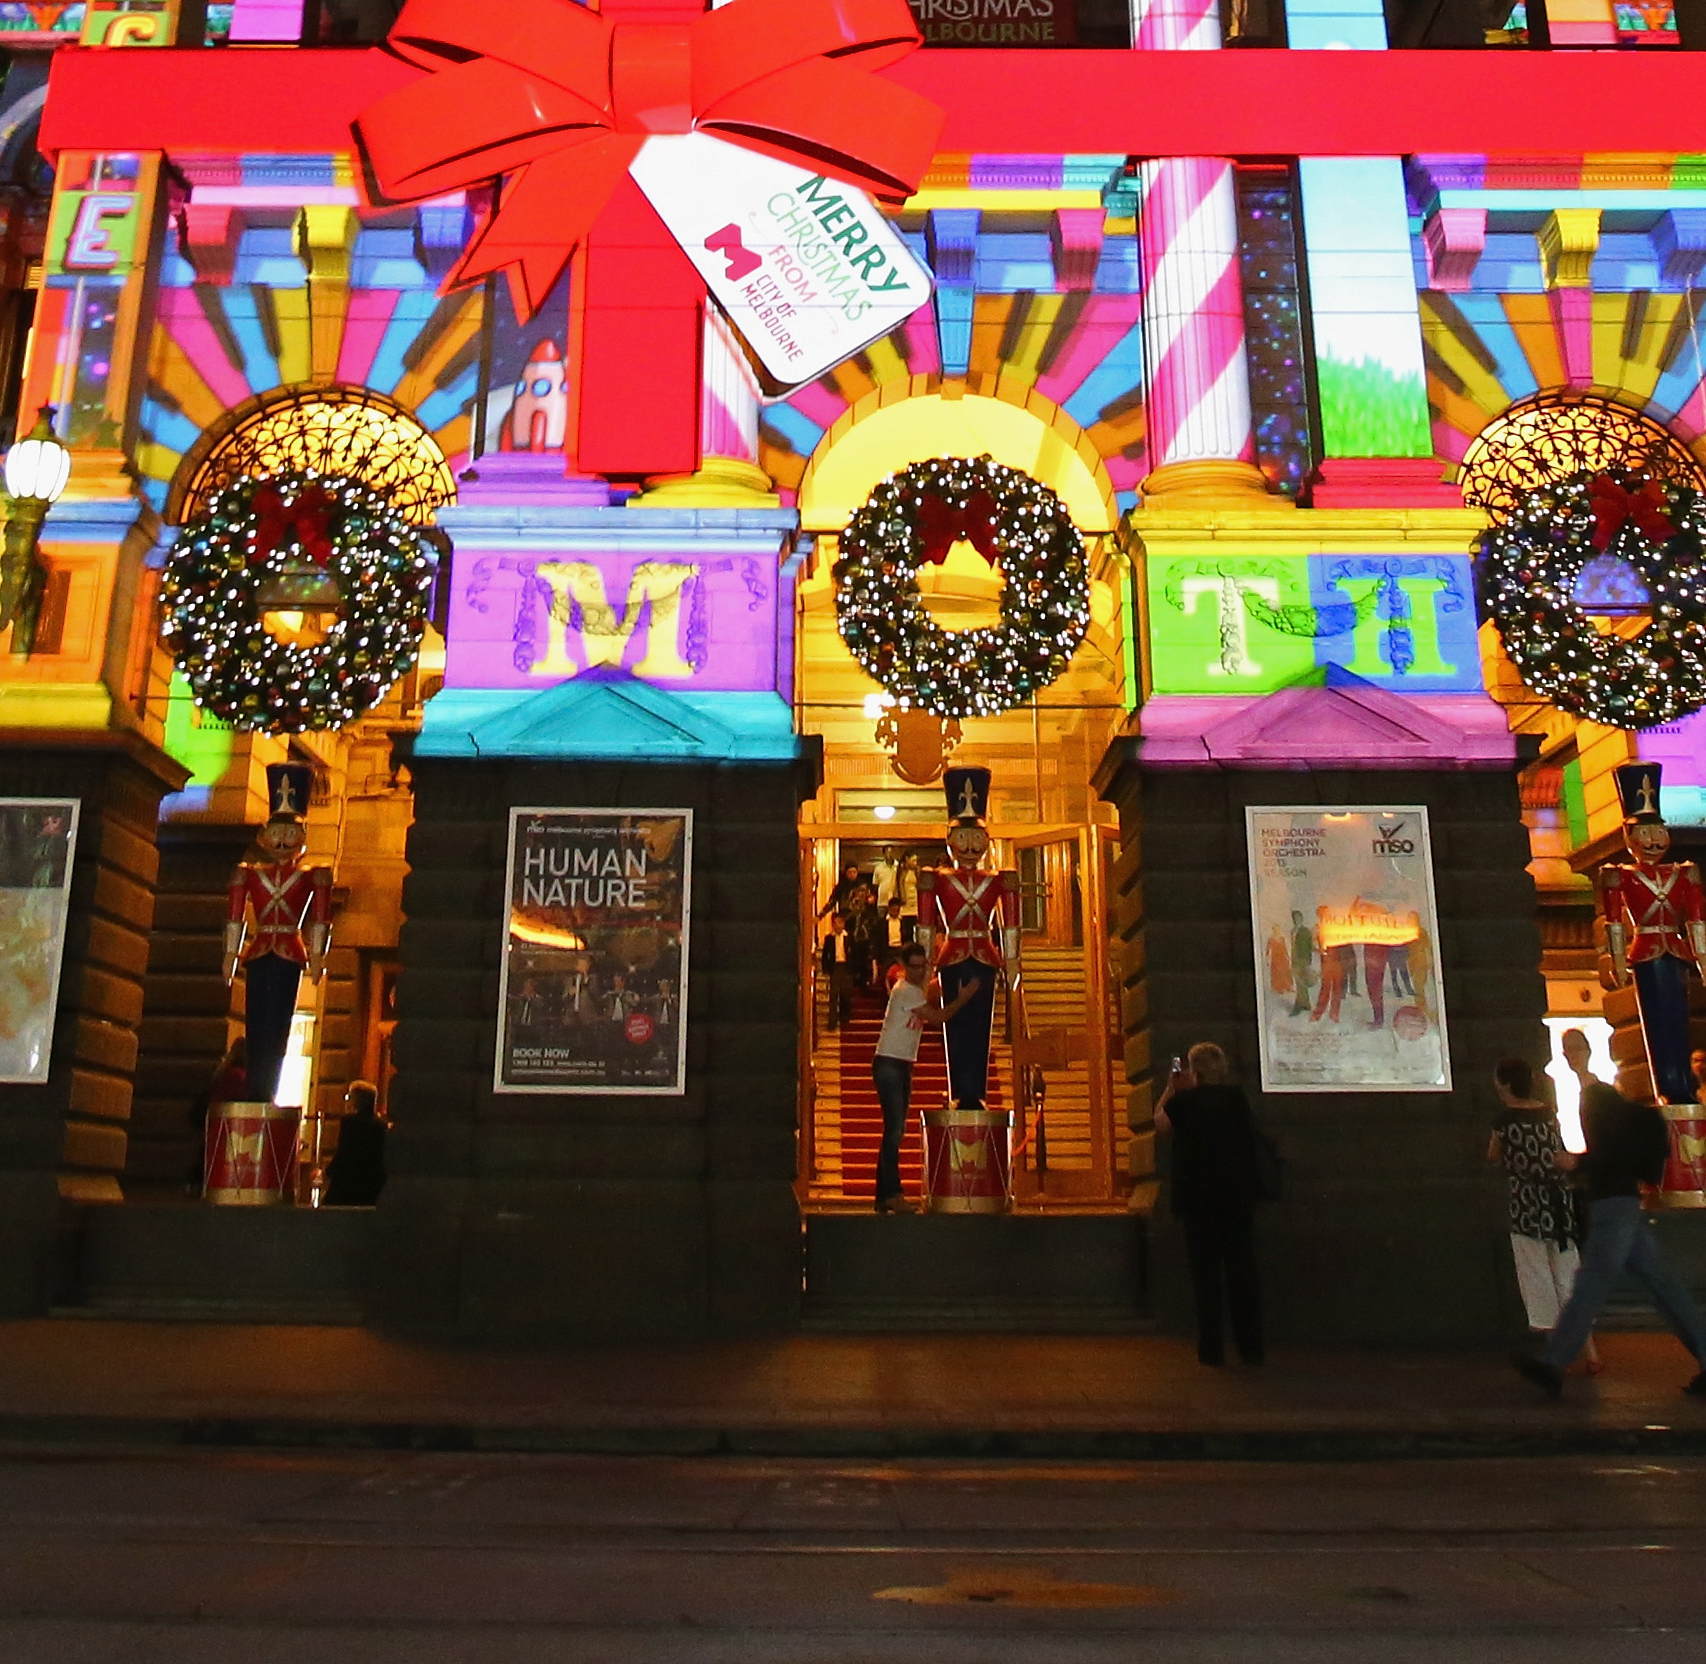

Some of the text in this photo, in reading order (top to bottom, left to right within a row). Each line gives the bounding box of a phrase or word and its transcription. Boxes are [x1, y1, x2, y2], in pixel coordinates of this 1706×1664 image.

[925, 22, 1055, 42] LBOURNE
[796, 173, 912, 293] MERRY
[767, 192, 873, 321] CHRISTMAS
[768, 245, 818, 303] FROM
[756, 274, 798, 319] CITY OF
[740, 283, 804, 363] MELBOURNE
[1261, 828, 1326, 837] MELBOURNE
[1262, 838, 1320, 847] SYMPHONY
[1372, 838, 1415, 854] mso
[523, 847, 648, 877] HUMAN
[1263, 848, 1326, 857] ORCHESTRA
[522, 878, 648, 908] NATURE
[544, 1048, 570, 1058] NOW
